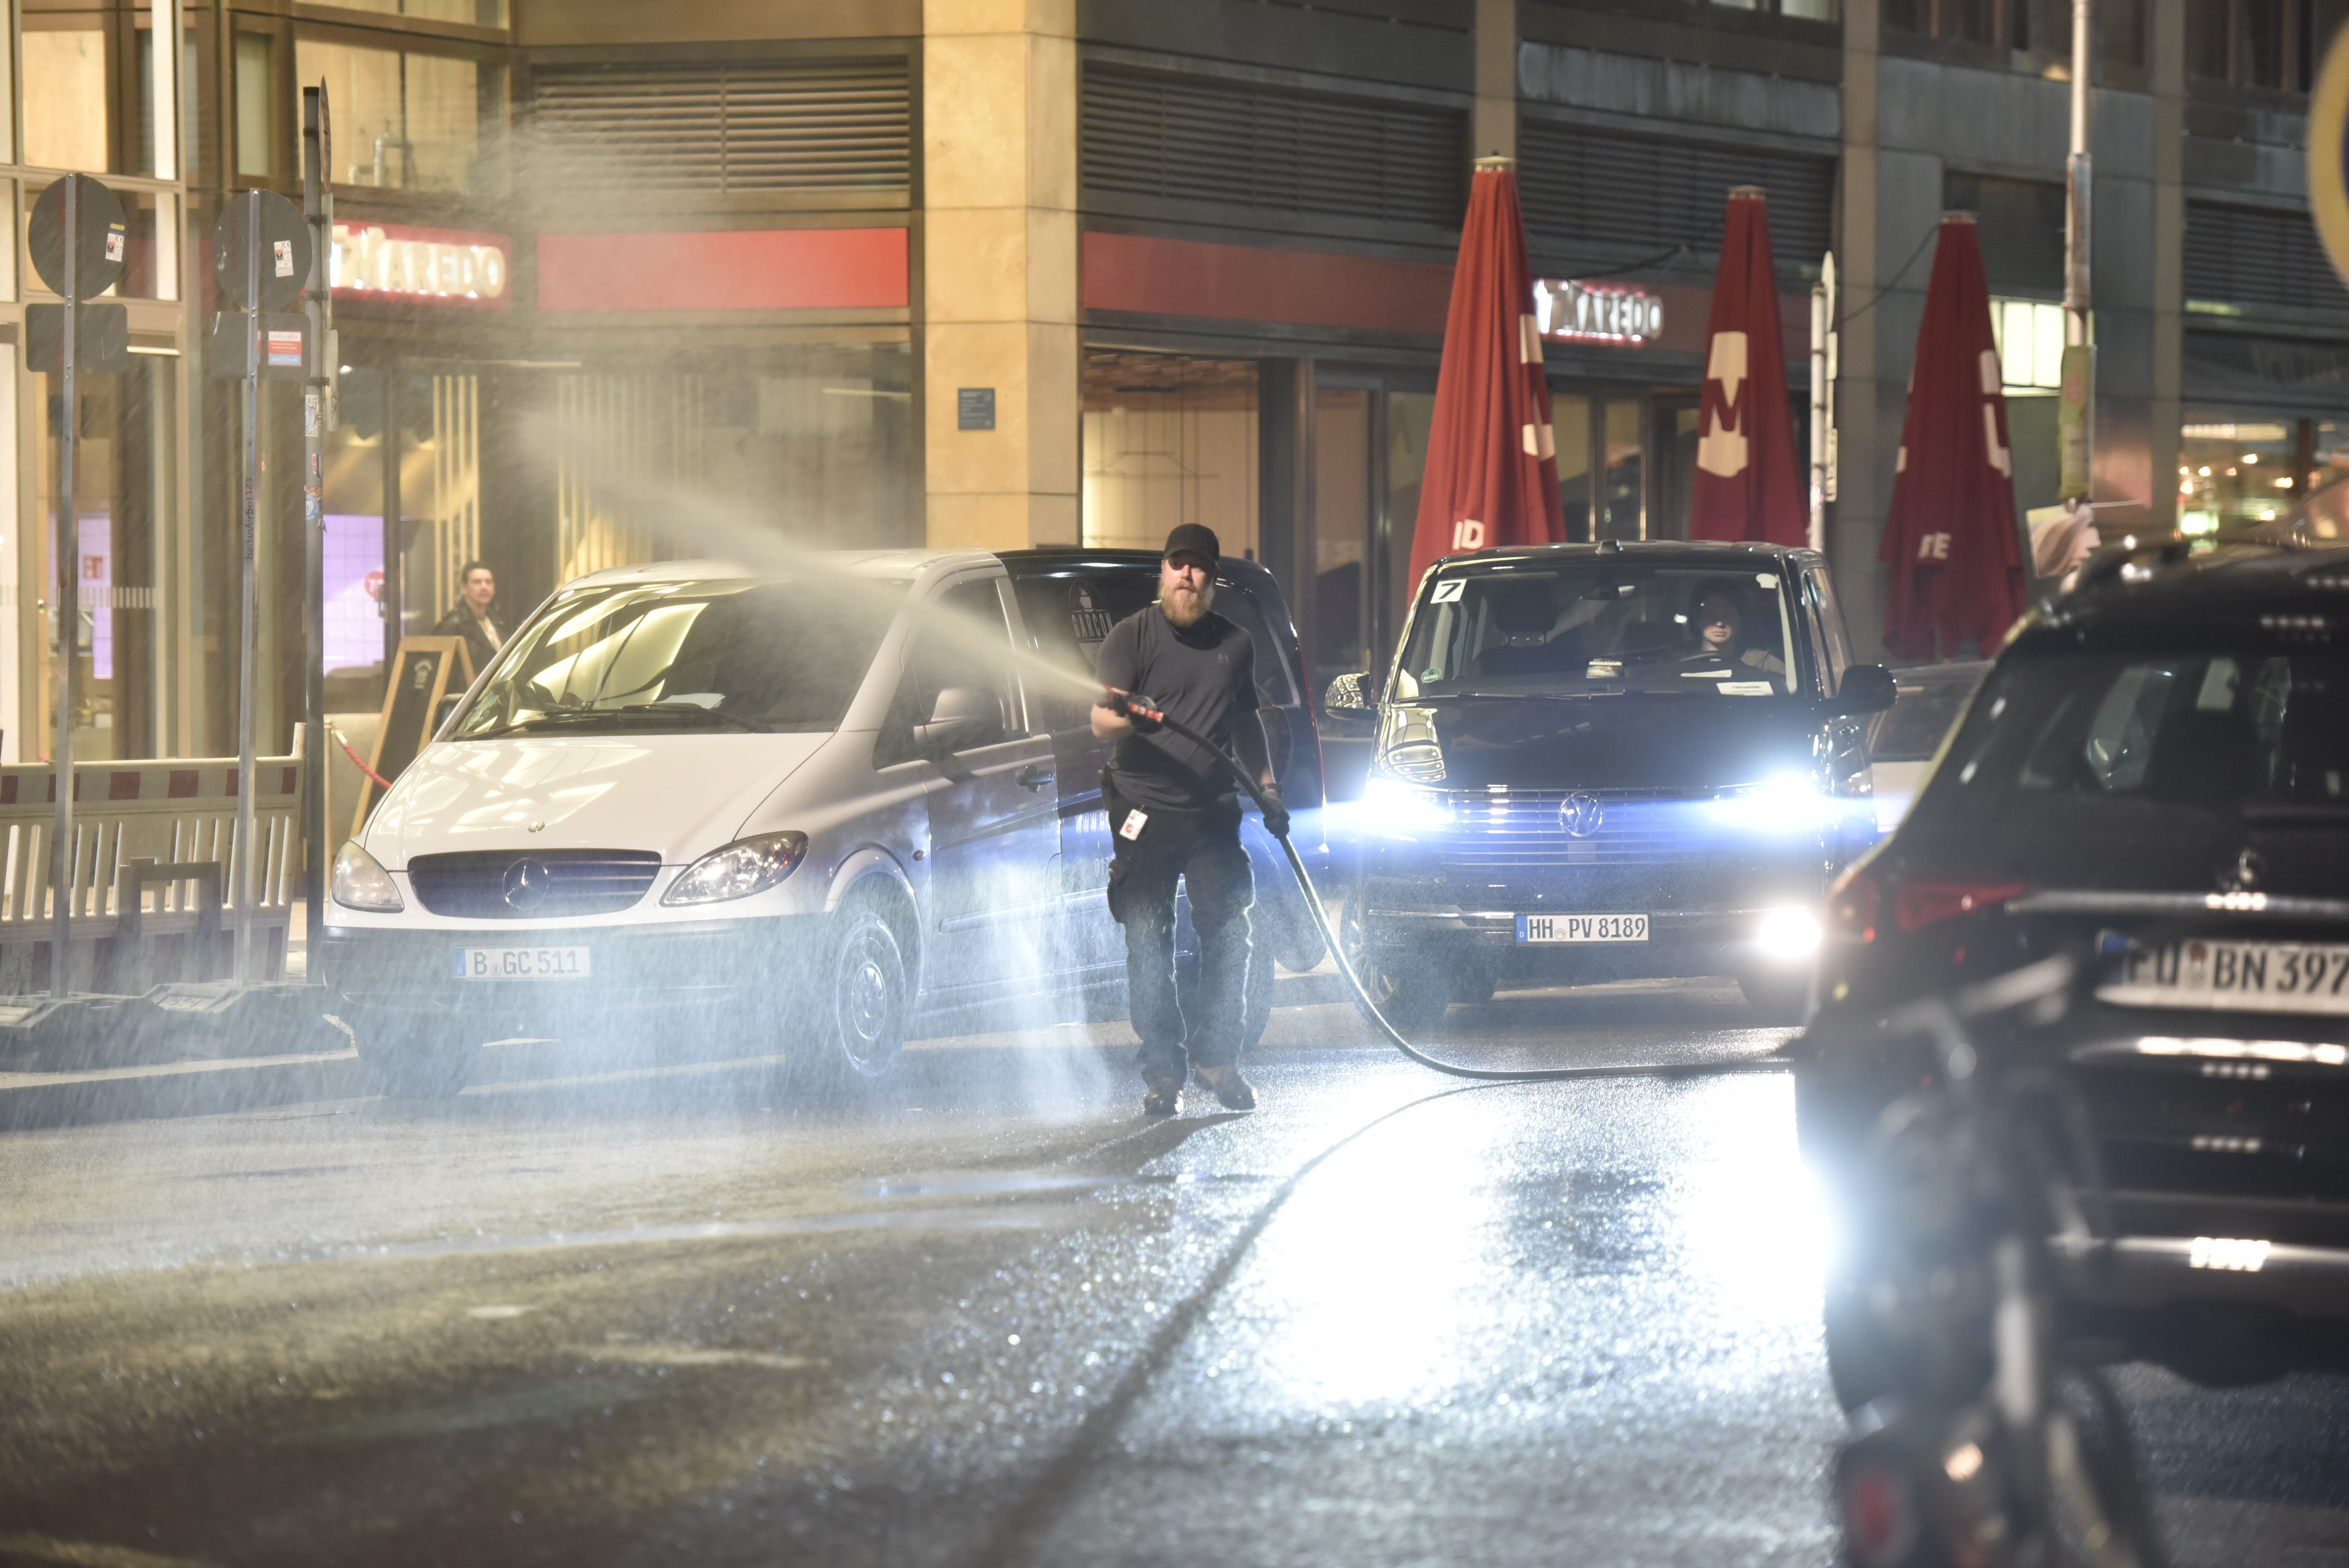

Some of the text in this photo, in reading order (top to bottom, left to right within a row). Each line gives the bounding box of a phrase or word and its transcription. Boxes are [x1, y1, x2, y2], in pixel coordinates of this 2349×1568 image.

[332, 225, 505, 298] MAREDO
[1438, 582, 1461, 600] 7
[1529, 919, 1553, 938] HH
[1569, 918, 1592, 938] PV
[1599, 918, 1645, 938] 8189
[474, 951, 487, 975] B
[503, 951, 531, 975] GC
[537, 949, 580, 974] 511
[2213, 948, 2268, 991] BN
